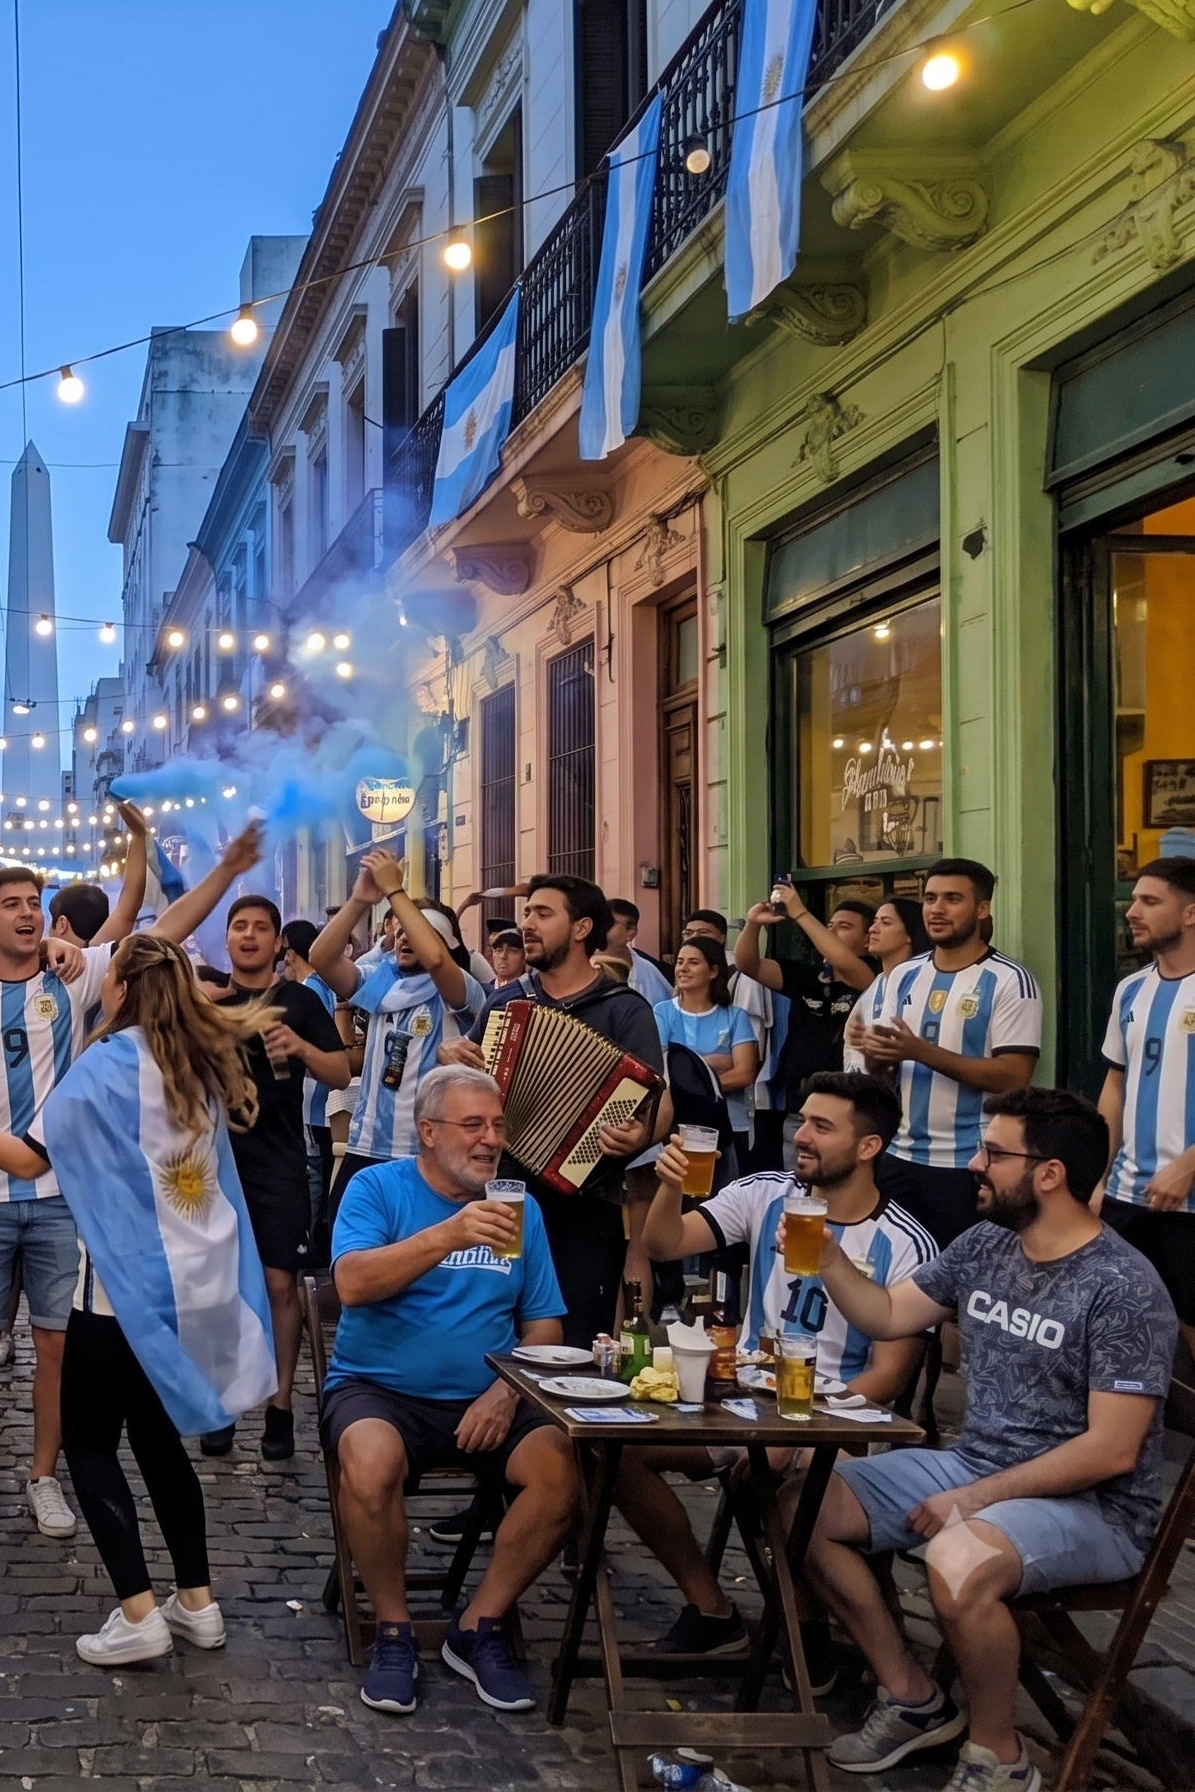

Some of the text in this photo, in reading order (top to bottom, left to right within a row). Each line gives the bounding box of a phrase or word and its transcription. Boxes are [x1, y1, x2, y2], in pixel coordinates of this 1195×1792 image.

[4, 1028, 29, 1068] 9
[1145, 1037, 1162, 1076] 9
[780, 1278, 829, 1333] 10
[967, 1289, 1065, 1349] CASIO
